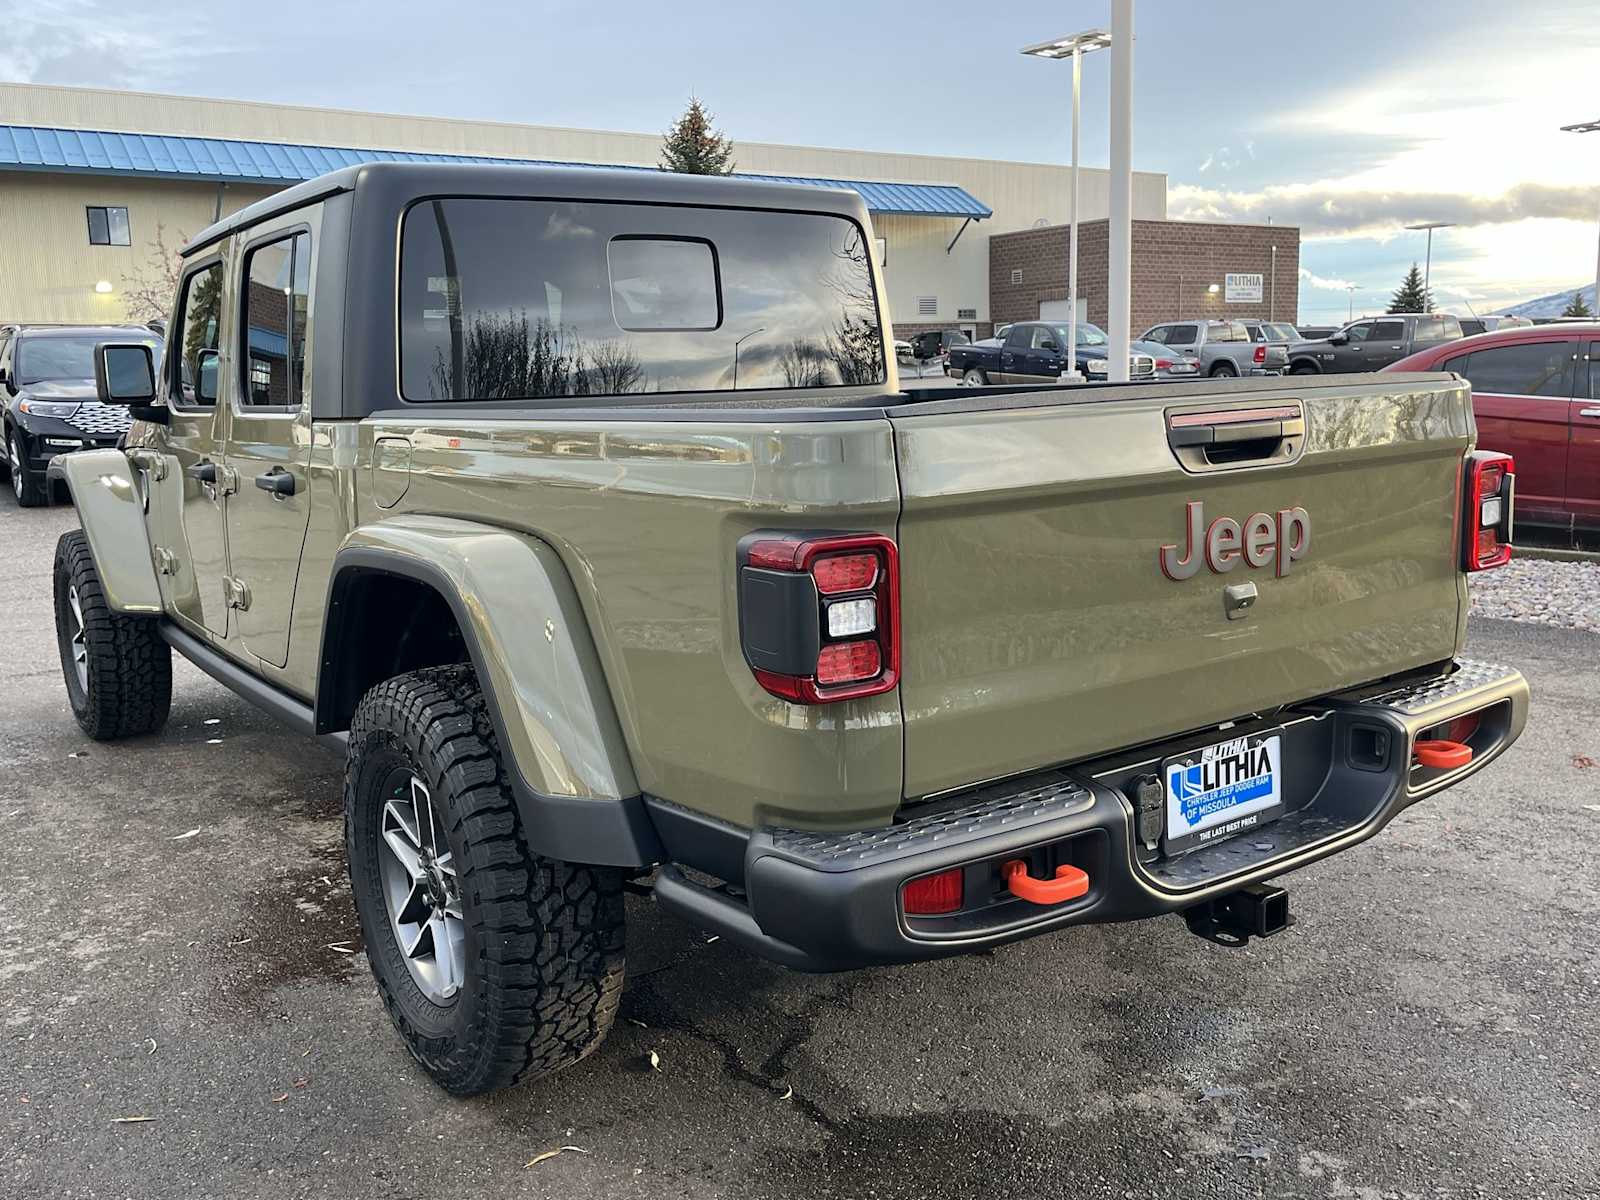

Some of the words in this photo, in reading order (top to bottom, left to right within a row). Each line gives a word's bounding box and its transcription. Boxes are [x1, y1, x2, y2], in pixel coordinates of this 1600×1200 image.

[1234, 275, 1261, 287] LITHIA
[1160, 501, 1311, 581] Jeep
[1212, 737, 1249, 760] LITHIA
[1203, 747, 1272, 792] LITHIA
[1186, 791, 1218, 808] CHRYSLER
[1218, 785, 1235, 798] JEEP
[1235, 780, 1256, 793] DODGE
[1256, 775, 1269, 787] RAM
[1186, 807, 1198, 819] OF
[1199, 795, 1237, 816] MISSOULA
[1200, 830, 1212, 841] THE
[1211, 825, 1226, 837] LAST
[1226, 821, 1241, 833] BEST
[1241, 815, 1257, 827] PRICE
